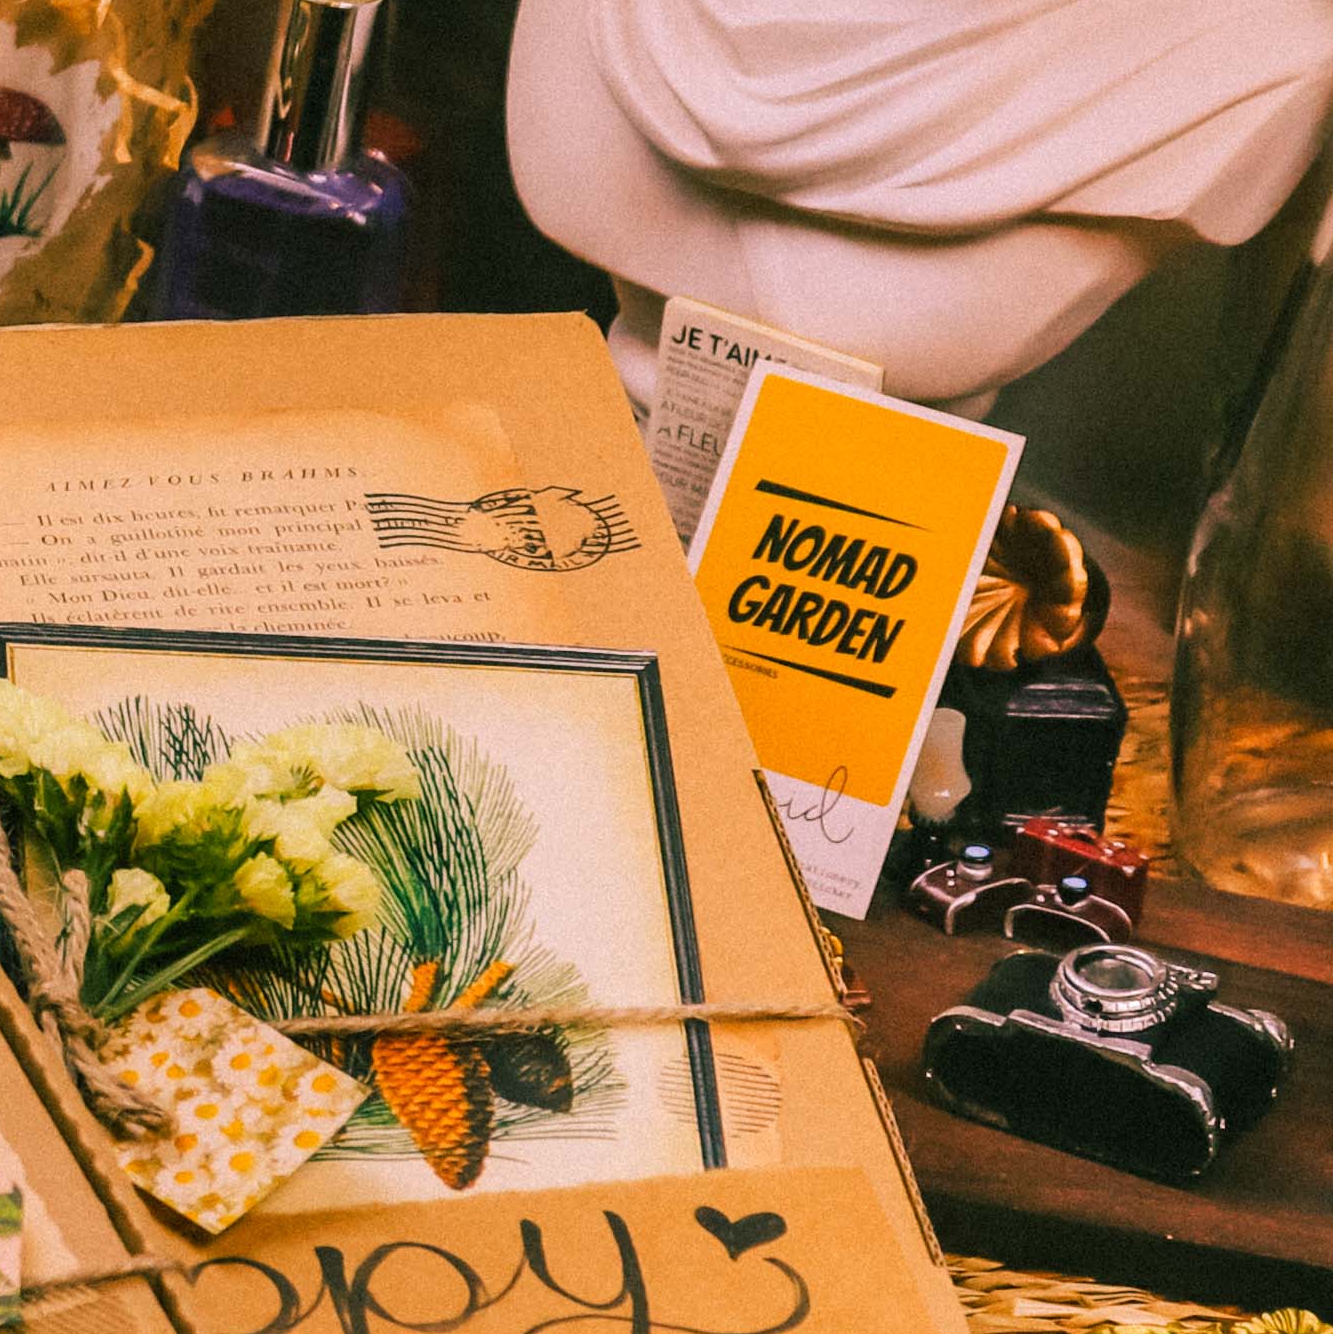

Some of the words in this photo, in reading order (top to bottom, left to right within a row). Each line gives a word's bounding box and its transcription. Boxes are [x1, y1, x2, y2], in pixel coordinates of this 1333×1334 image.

[671, 325, 704, 351] JE
[46, 477, 131, 492] AIMEZ
[149, 473, 221, 486] VOUS
[235, 503, 340, 518] remarquer
[275, 519, 362, 538] principal
[750, 512, 919, 601] NOMAD
[20, 574, 58, 586] Elle
[198, 562, 264, 579] gardait
[49, 592, 93, 604] Mon
[423, 592, 462, 605] leva
[727, 573, 907, 664] GARDEN
